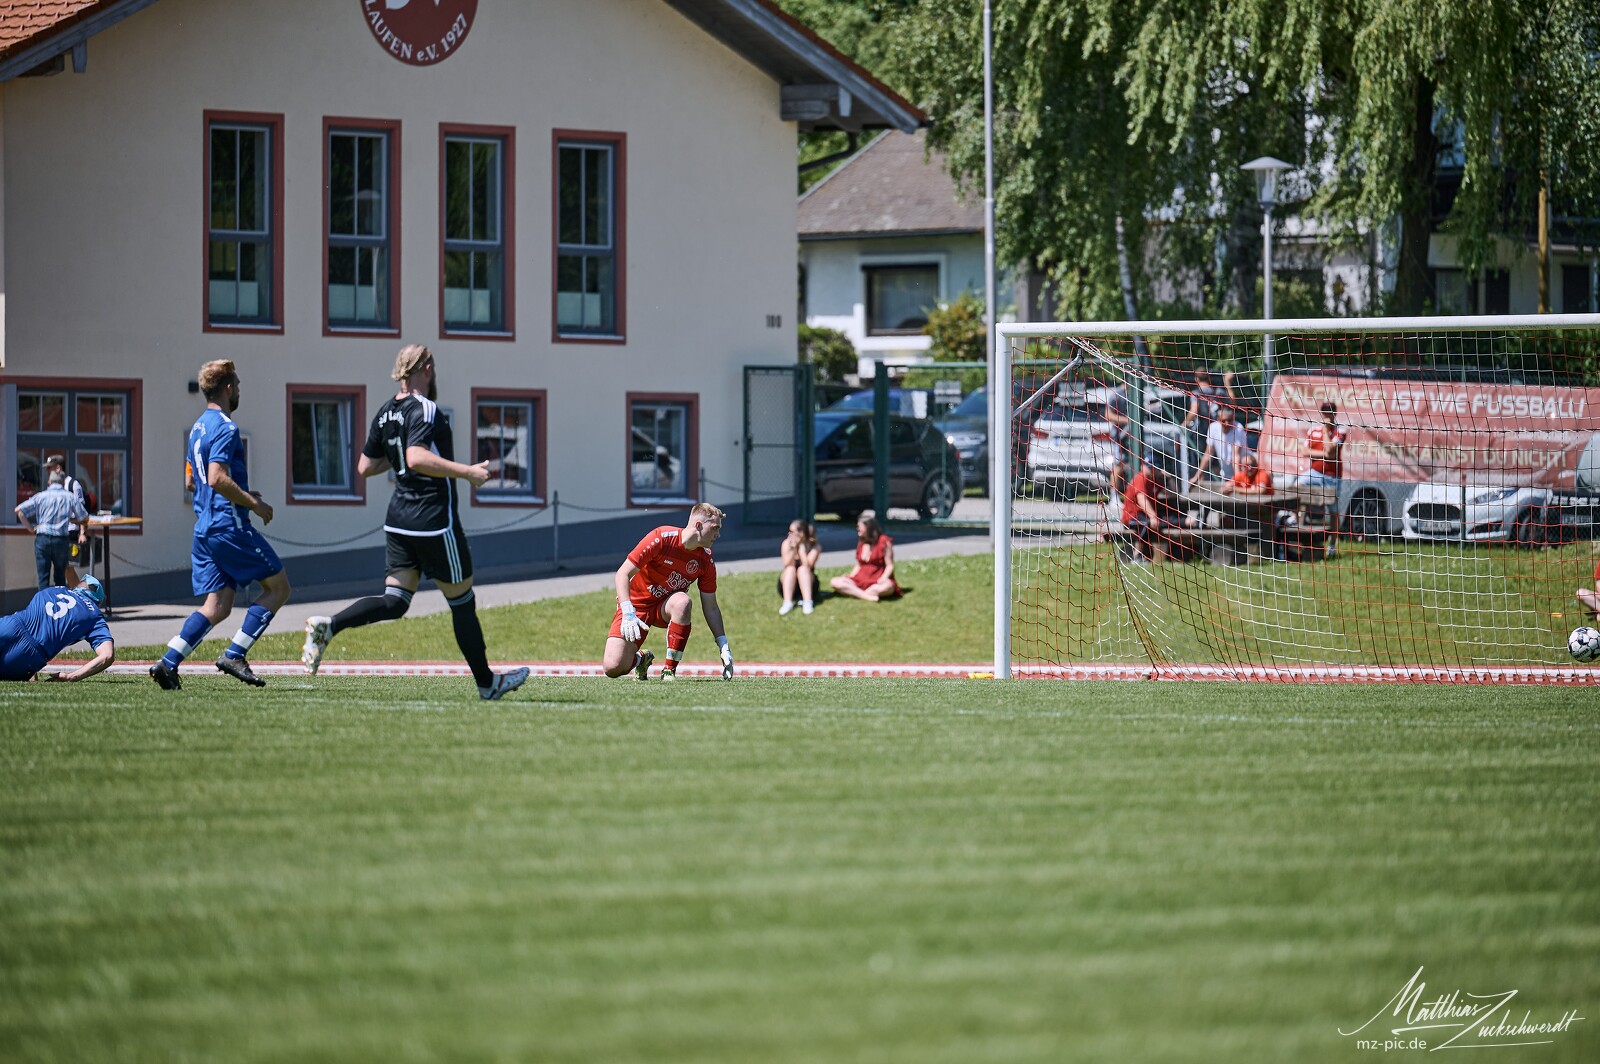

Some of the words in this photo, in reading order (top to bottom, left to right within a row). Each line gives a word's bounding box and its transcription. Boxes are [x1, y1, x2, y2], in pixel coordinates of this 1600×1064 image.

[365, 0, 413, 59] LAUFEN
[416, 43, 440, 62] e.V.
[440, 12, 468, 52] 1927
[1279, 384, 1388, 409] PALFINGER
[1390, 389, 1425, 412] IST
[1429, 391, 1468, 413] WIE
[1472, 393, 1586, 418] FUSSBALL!
[1406, 443, 1475, 464] KANNST
[1482, 446, 1507, 465] DU
[45, 593, 77, 621] 3
